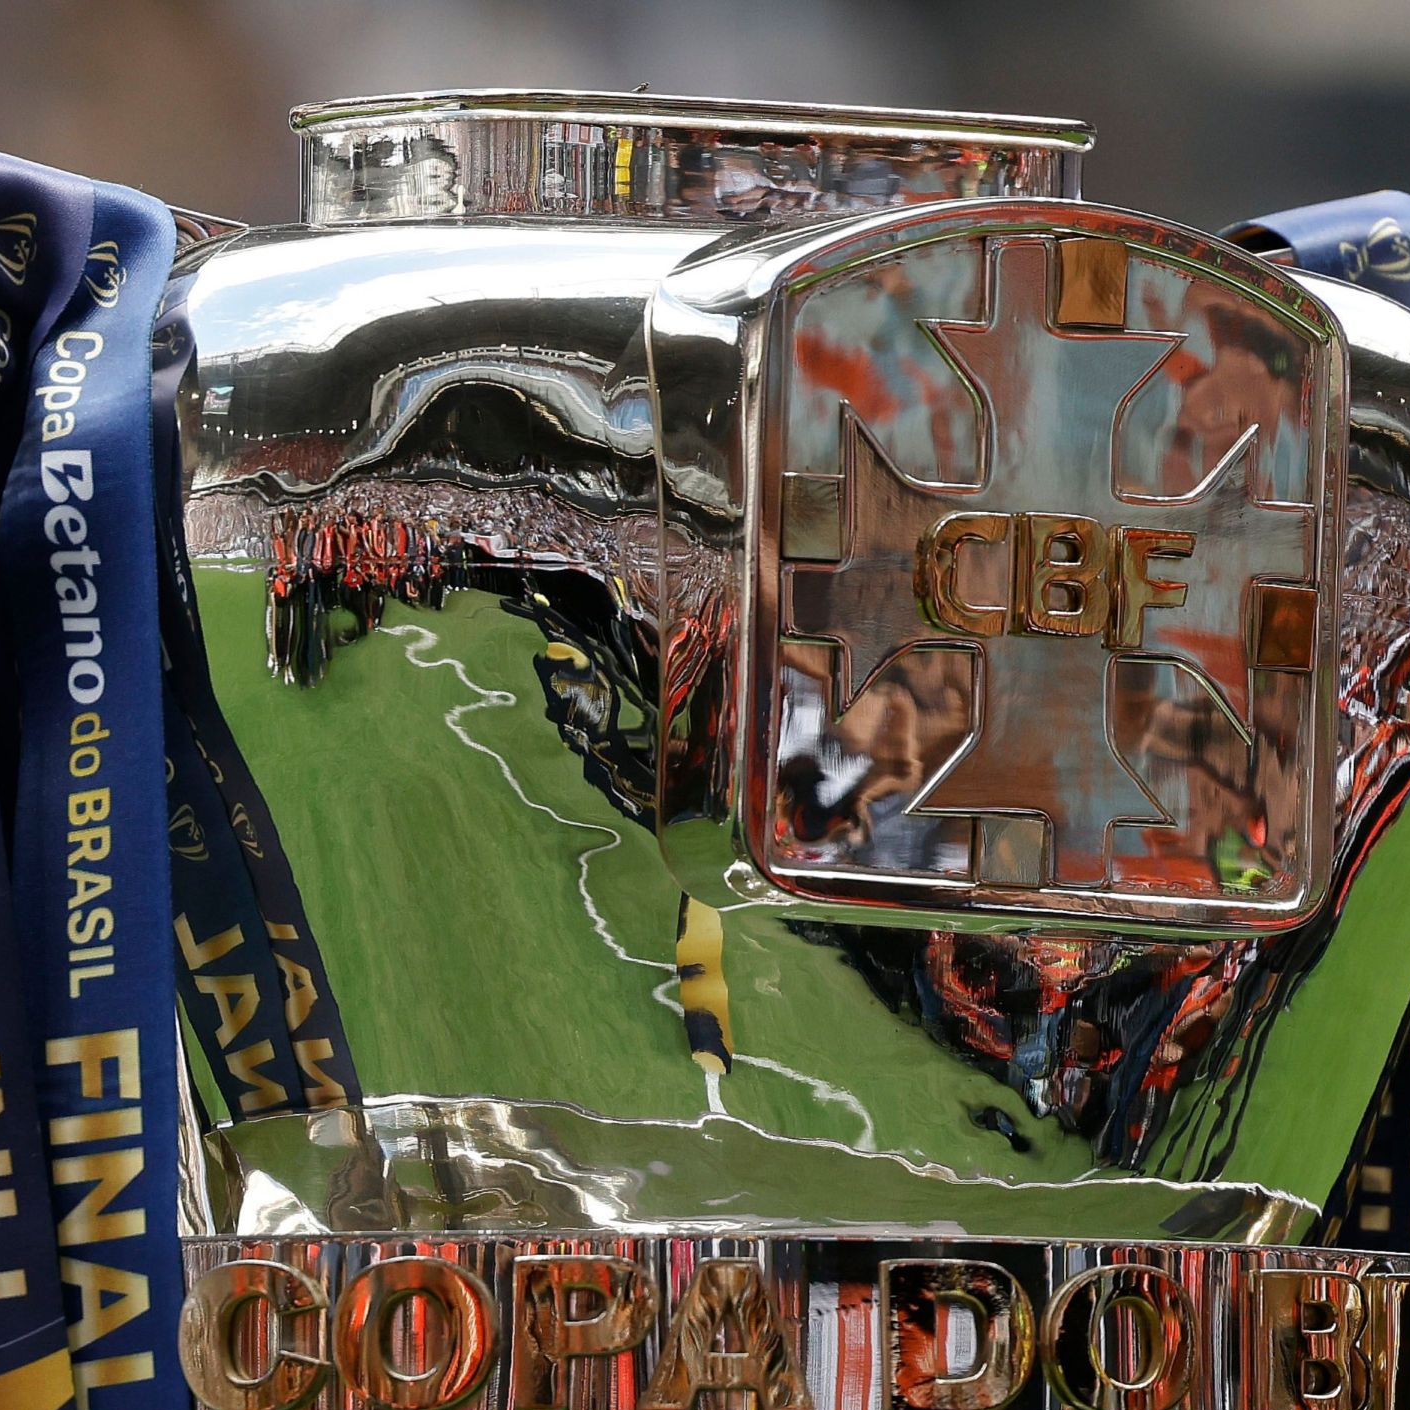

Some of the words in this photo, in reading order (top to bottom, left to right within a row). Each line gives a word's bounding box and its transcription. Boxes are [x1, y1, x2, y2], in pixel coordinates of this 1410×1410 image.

[35, 331, 104, 441] Copa
[41, 449, 105, 704] Betano
[913, 510, 1198, 649] CBF
[69, 711, 111, 777] do
[67, 785, 116, 999] BRASIL
